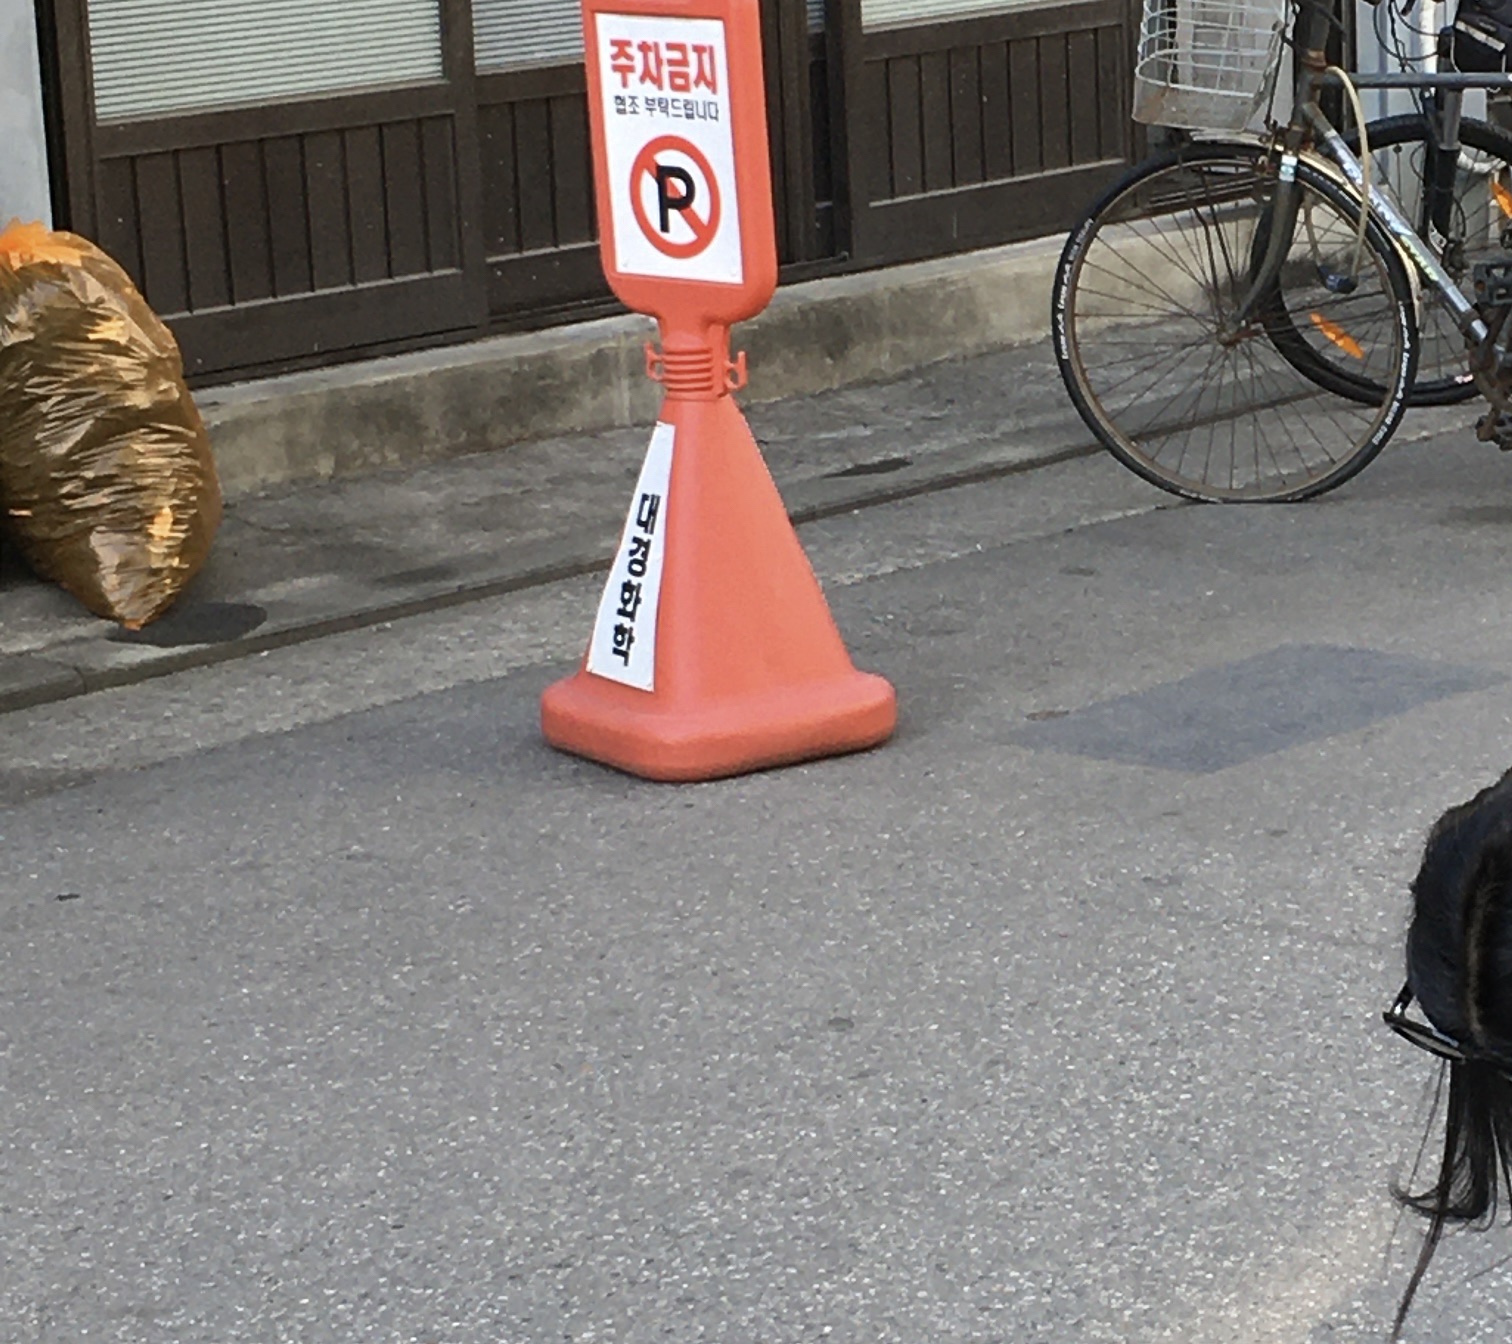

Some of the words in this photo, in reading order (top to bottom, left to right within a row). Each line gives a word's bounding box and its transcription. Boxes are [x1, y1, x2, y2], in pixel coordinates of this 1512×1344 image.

[609, 37, 719, 95] 주차금지
[614, 94, 640, 115] 협조
[644, 95, 720, 121] 부탁드립니다
[611, 492, 662, 667] 대경화학
